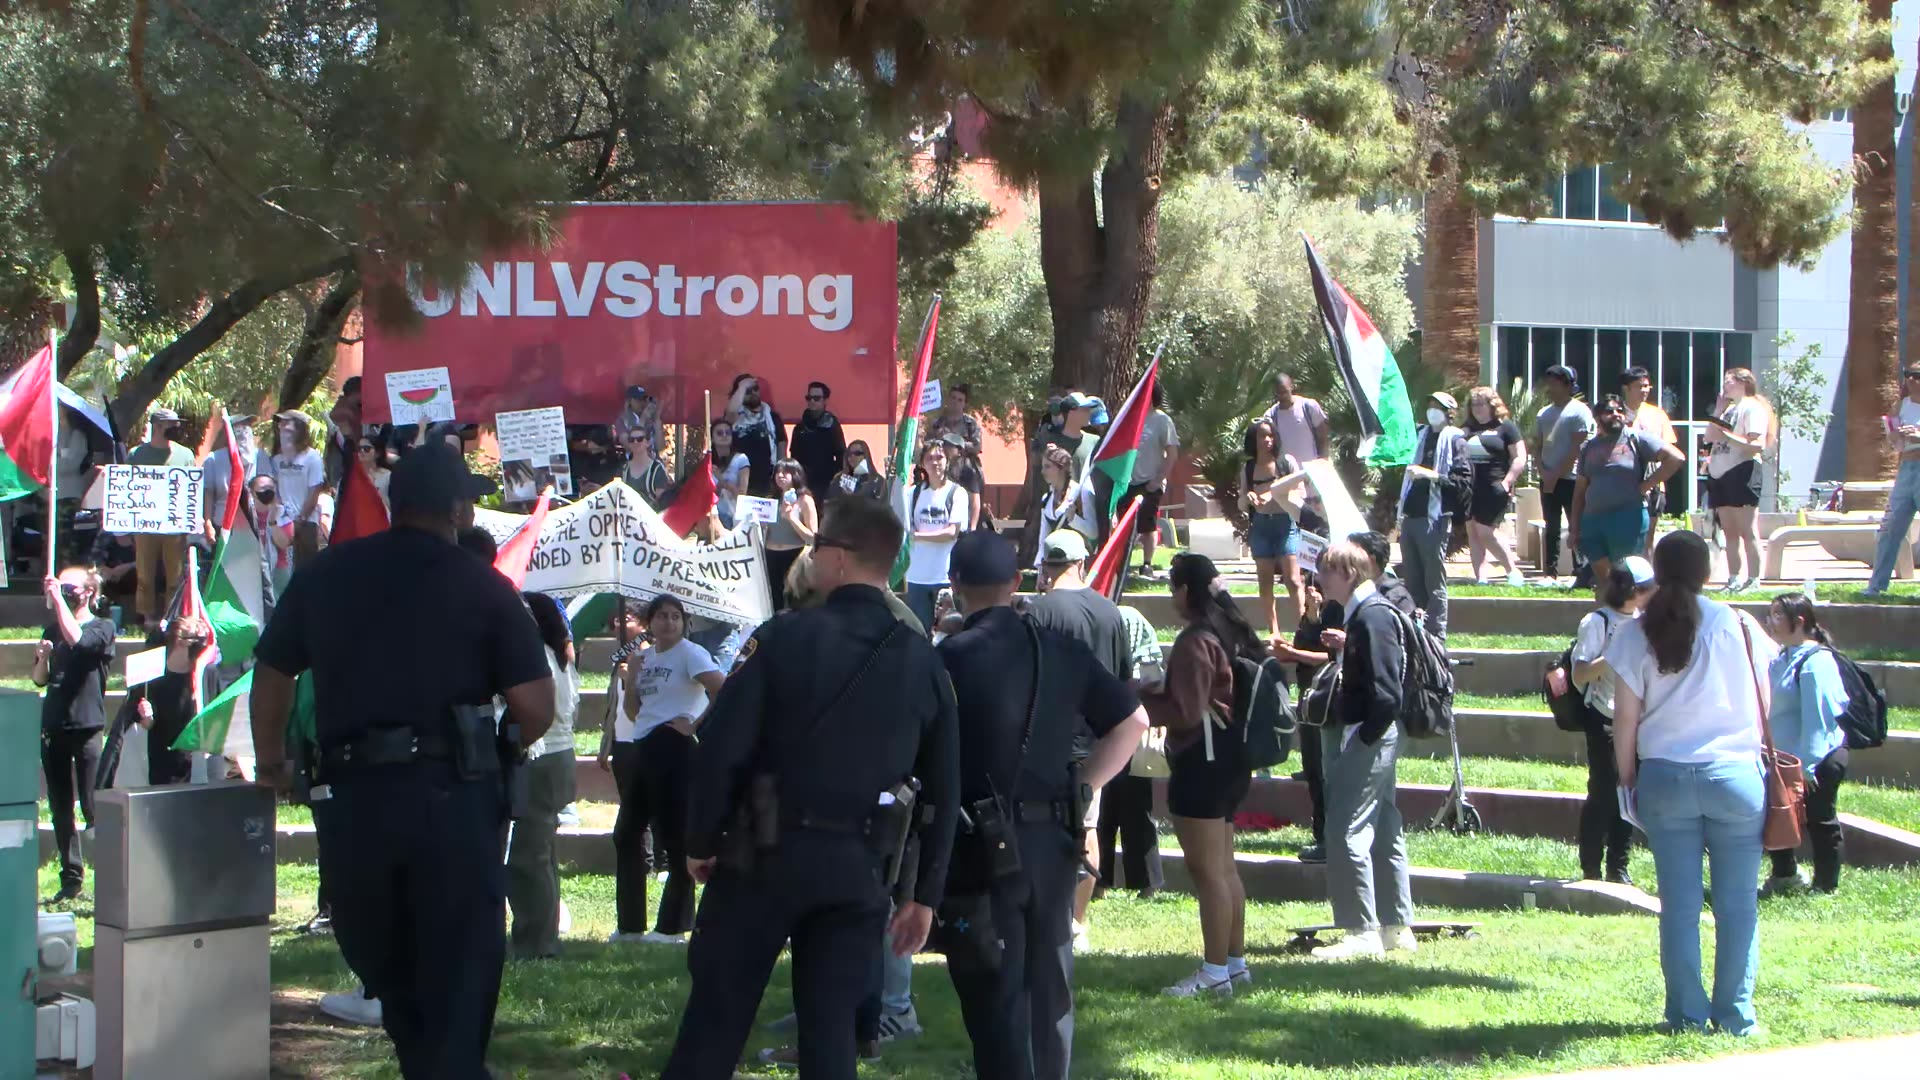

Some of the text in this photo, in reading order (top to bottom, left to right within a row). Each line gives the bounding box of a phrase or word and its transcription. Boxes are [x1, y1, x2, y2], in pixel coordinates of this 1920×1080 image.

[109, 466, 130, 478] Free
[108, 494, 127, 509] Free
[106, 511, 128, 526] Free
[581, 542, 603, 565] BY
[699, 557, 754, 581] MUST
